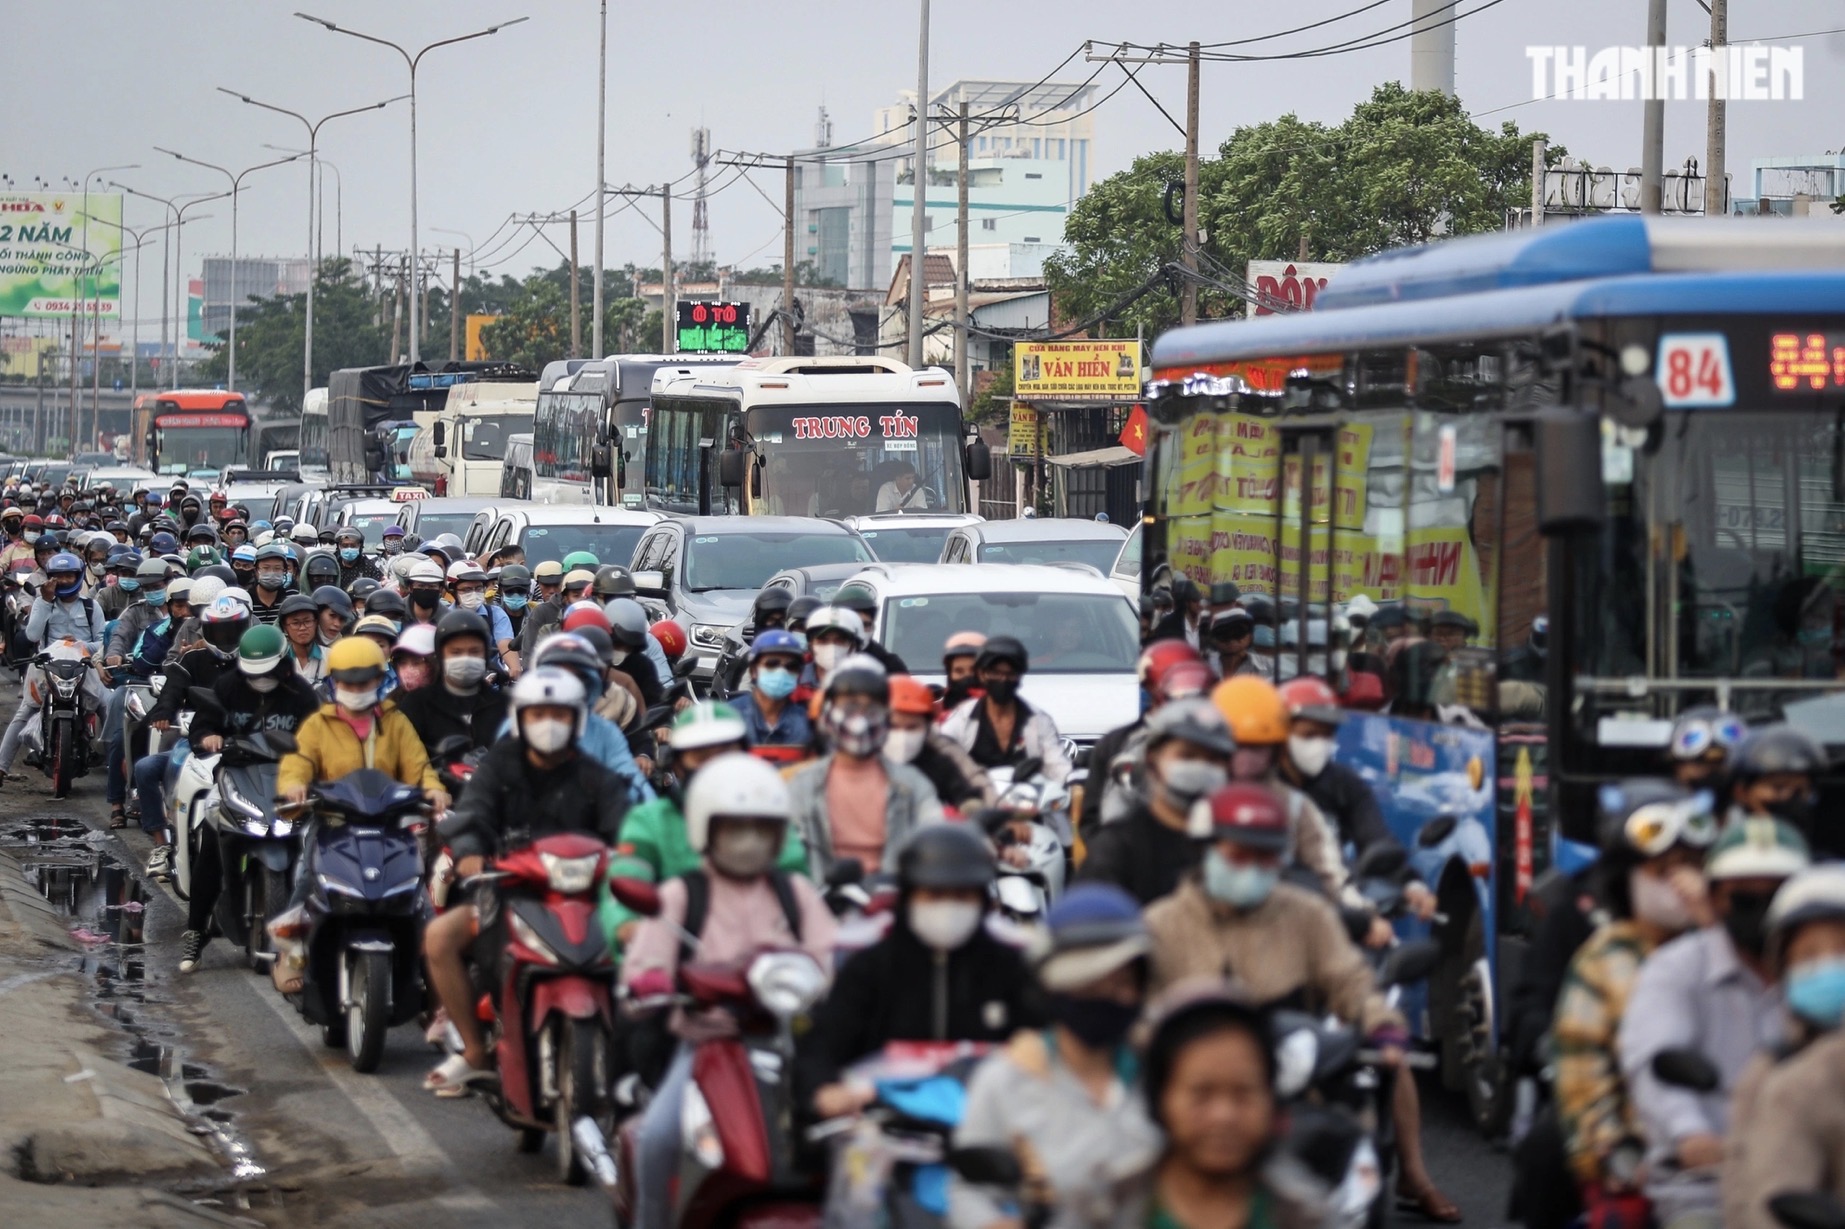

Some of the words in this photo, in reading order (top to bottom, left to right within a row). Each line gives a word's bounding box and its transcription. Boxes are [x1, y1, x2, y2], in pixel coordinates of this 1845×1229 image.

[18, 221, 73, 243] NĂM
[711, 305, 737, 322] TÔ
[1043, 357, 1074, 378] VĂN
[1077, 353, 1111, 378] HIỂN
[1667, 347, 1723, 398] 84
[792, 416, 871, 440] TRUNG
[879, 409, 919, 439] TÍN
[399, 492, 423, 500] TAXI
